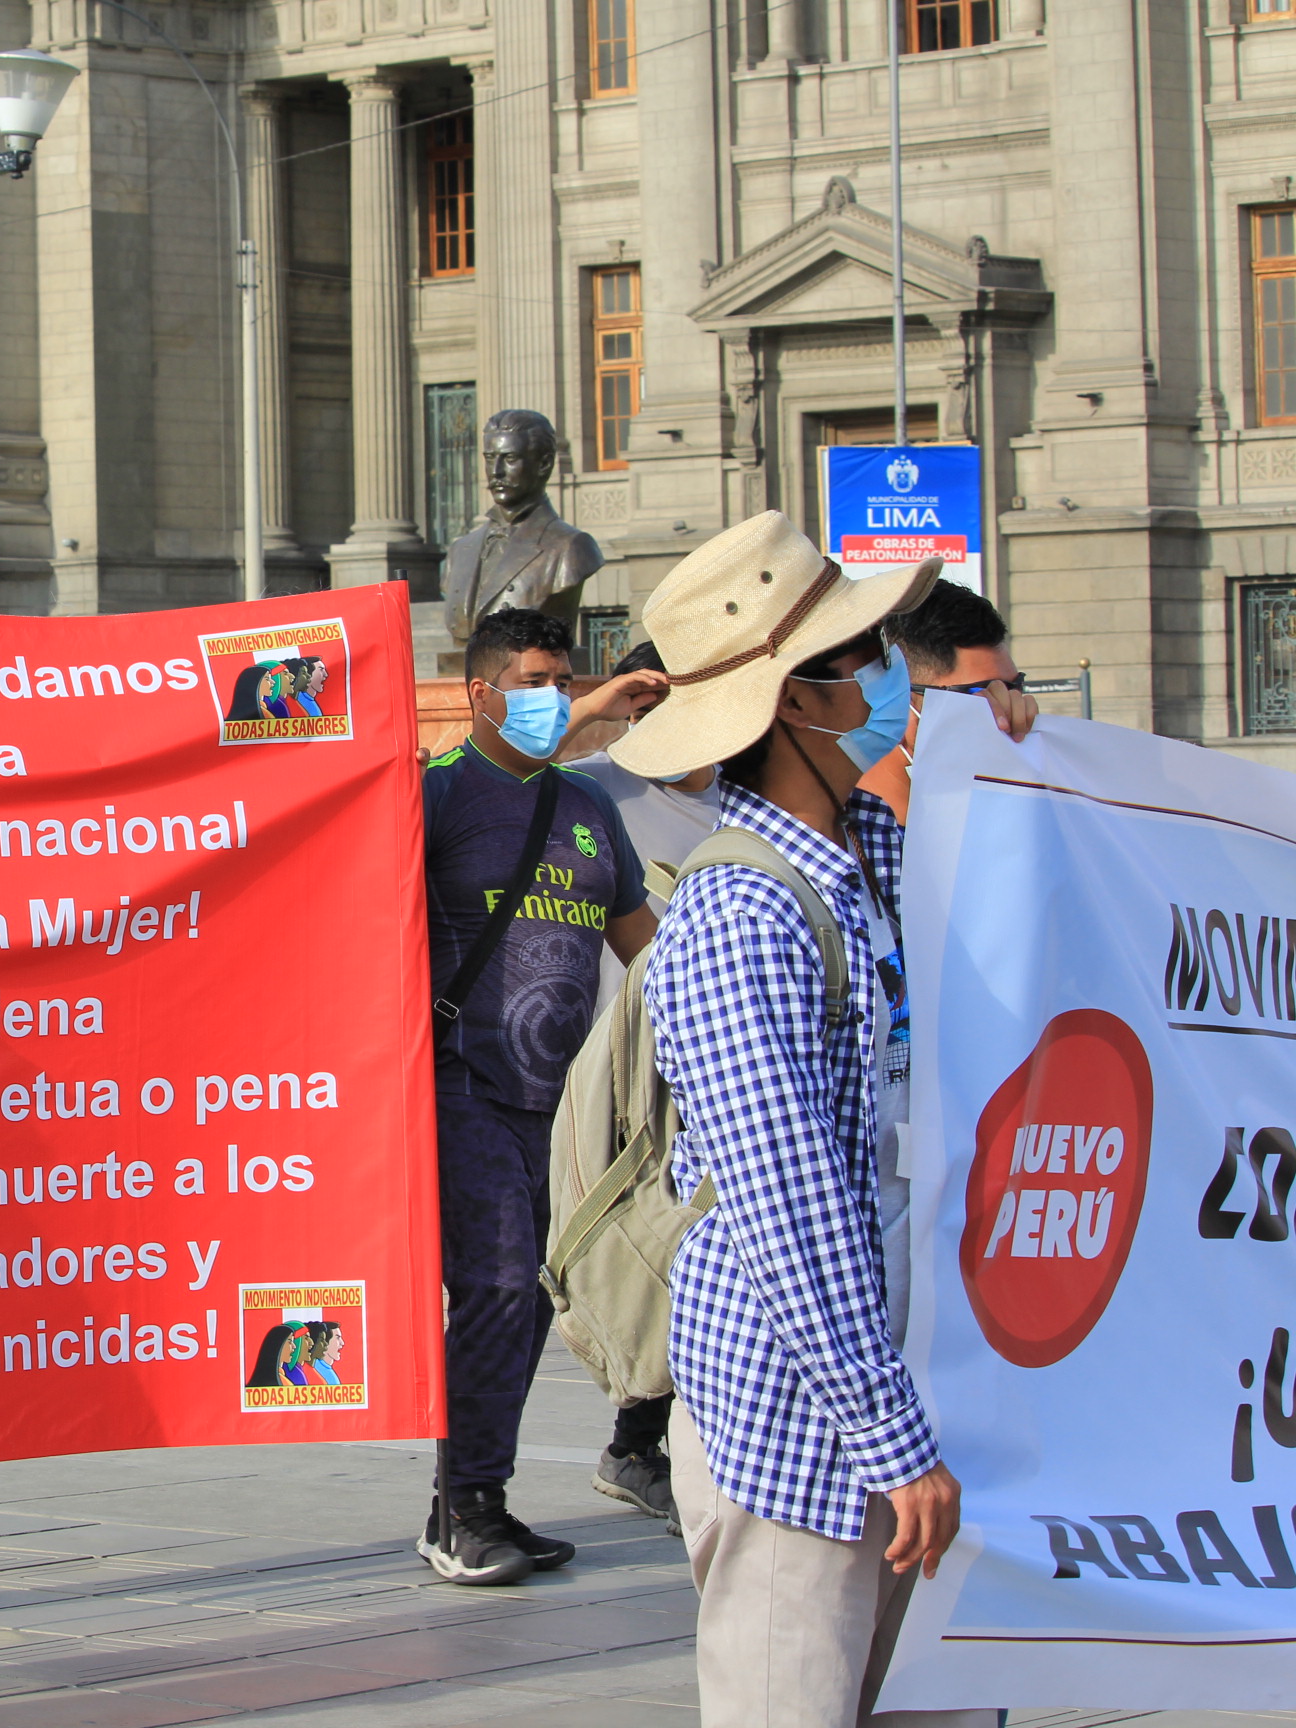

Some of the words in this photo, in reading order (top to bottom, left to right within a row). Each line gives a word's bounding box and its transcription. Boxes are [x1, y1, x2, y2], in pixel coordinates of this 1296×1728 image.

[867, 496, 926, 504] MUNICIPALIDAD
[929, 496, 939, 504] DE
[867, 508, 941, 528] LIMA
[846, 548, 962, 561] PEATONALIZACIÓN
[873, 538, 916, 549] OBRAS
[918, 538, 934, 549] DE
[206, 634, 274, 655] MOVIMIENTO
[276, 625, 340, 647] INDIGNADOS
[225, 721, 265, 739] TODAS
[267, 719, 289, 737] LAS
[291, 717, 347, 736] SANGRES
[534, 862, 574, 891] Fly
[28, 890, 201, 956] Mujer!
[140, 1076, 174, 1114] o
[195, 1069, 339, 1125] pena
[1009, 1124, 1124, 1176] NUEVO
[174, 1156, 205, 1195] a
[227, 1144, 315, 1194] los
[983, 1187, 1115, 1260] PERÚ
[187, 1240, 221, 1290] y
[245, 1290, 302, 1308] MOVIMIENTO
[303, 1288, 361, 1305] INDIGNADOS
[245, 1387, 284, 1406] TODAS
[286, 1386, 308, 1405] LAS
[310, 1385, 363, 1404] SANGRES
[1030, 1504, 1296, 1589] ABAJ
